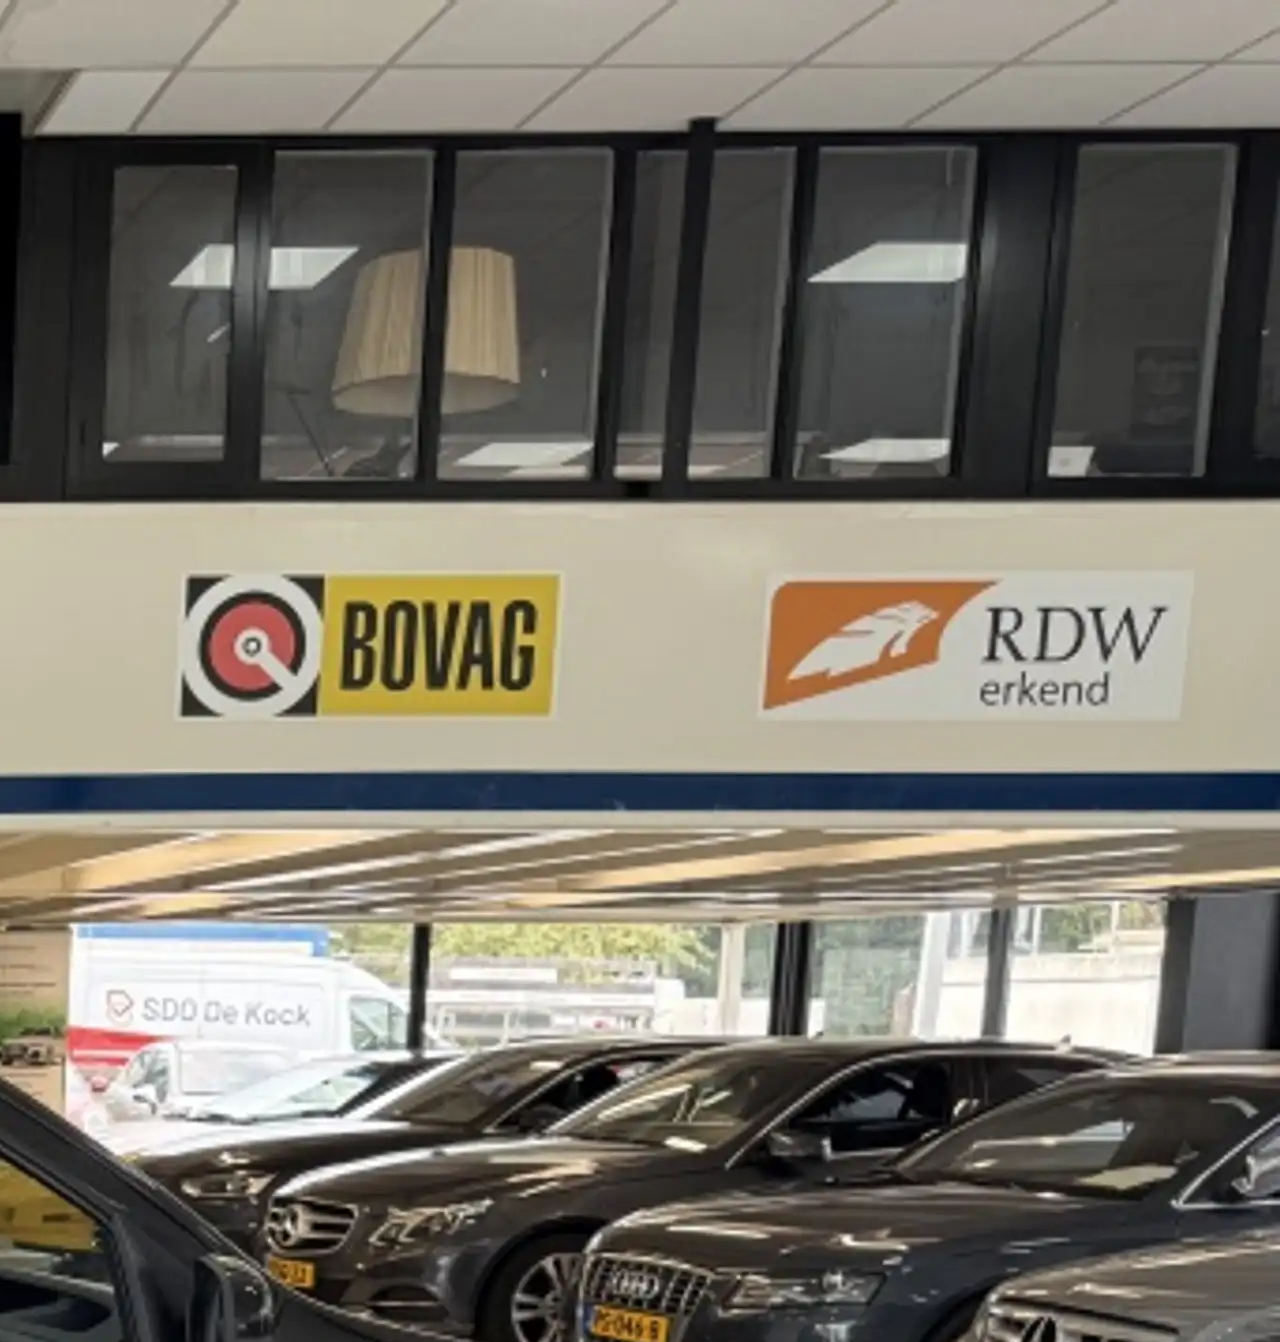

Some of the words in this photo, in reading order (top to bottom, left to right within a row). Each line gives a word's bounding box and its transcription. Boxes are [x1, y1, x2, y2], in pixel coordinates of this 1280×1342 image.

[340, 600, 538, 691] BOVAG
[980, 606, 1169, 664] RDW
[979, 671, 1110, 706] erkend
